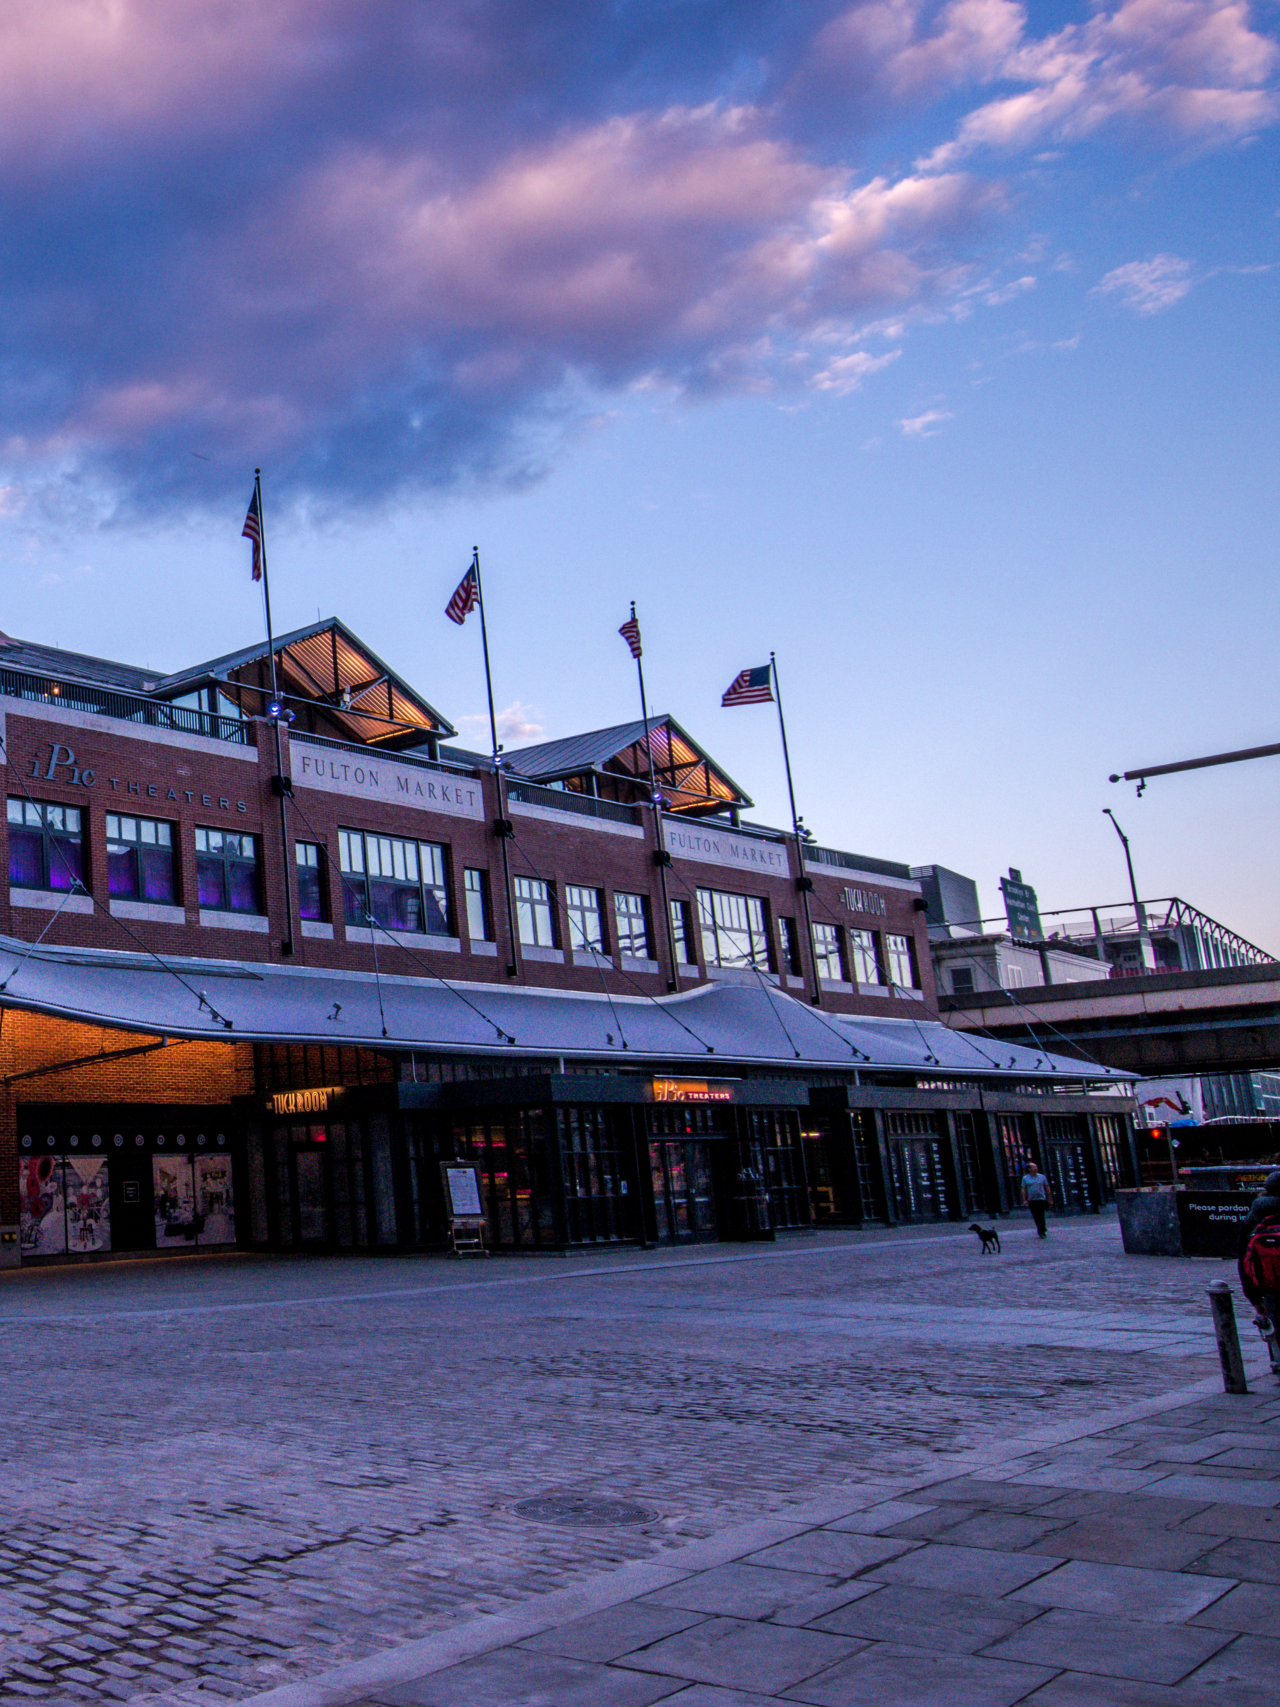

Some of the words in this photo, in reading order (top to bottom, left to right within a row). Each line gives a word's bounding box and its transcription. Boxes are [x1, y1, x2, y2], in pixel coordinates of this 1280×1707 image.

[28, 743, 96, 787] iPic
[109, 778, 247, 813] THEATERS
[301, 755, 380, 788] FULTON
[396, 775, 476, 807] MARKET
[670, 832, 721, 855] FULTON
[729, 845, 783, 868] MARKET
[657, 1080, 686, 1101] iPic
[272, 1093, 296, 1115] TUCK
[296, 1091, 329, 1113] ROOM
[1188, 1203, 1217, 1212] Please
[1218, 1204, 1250, 1213] pardon
[1208, 1213, 1238, 1223] during
